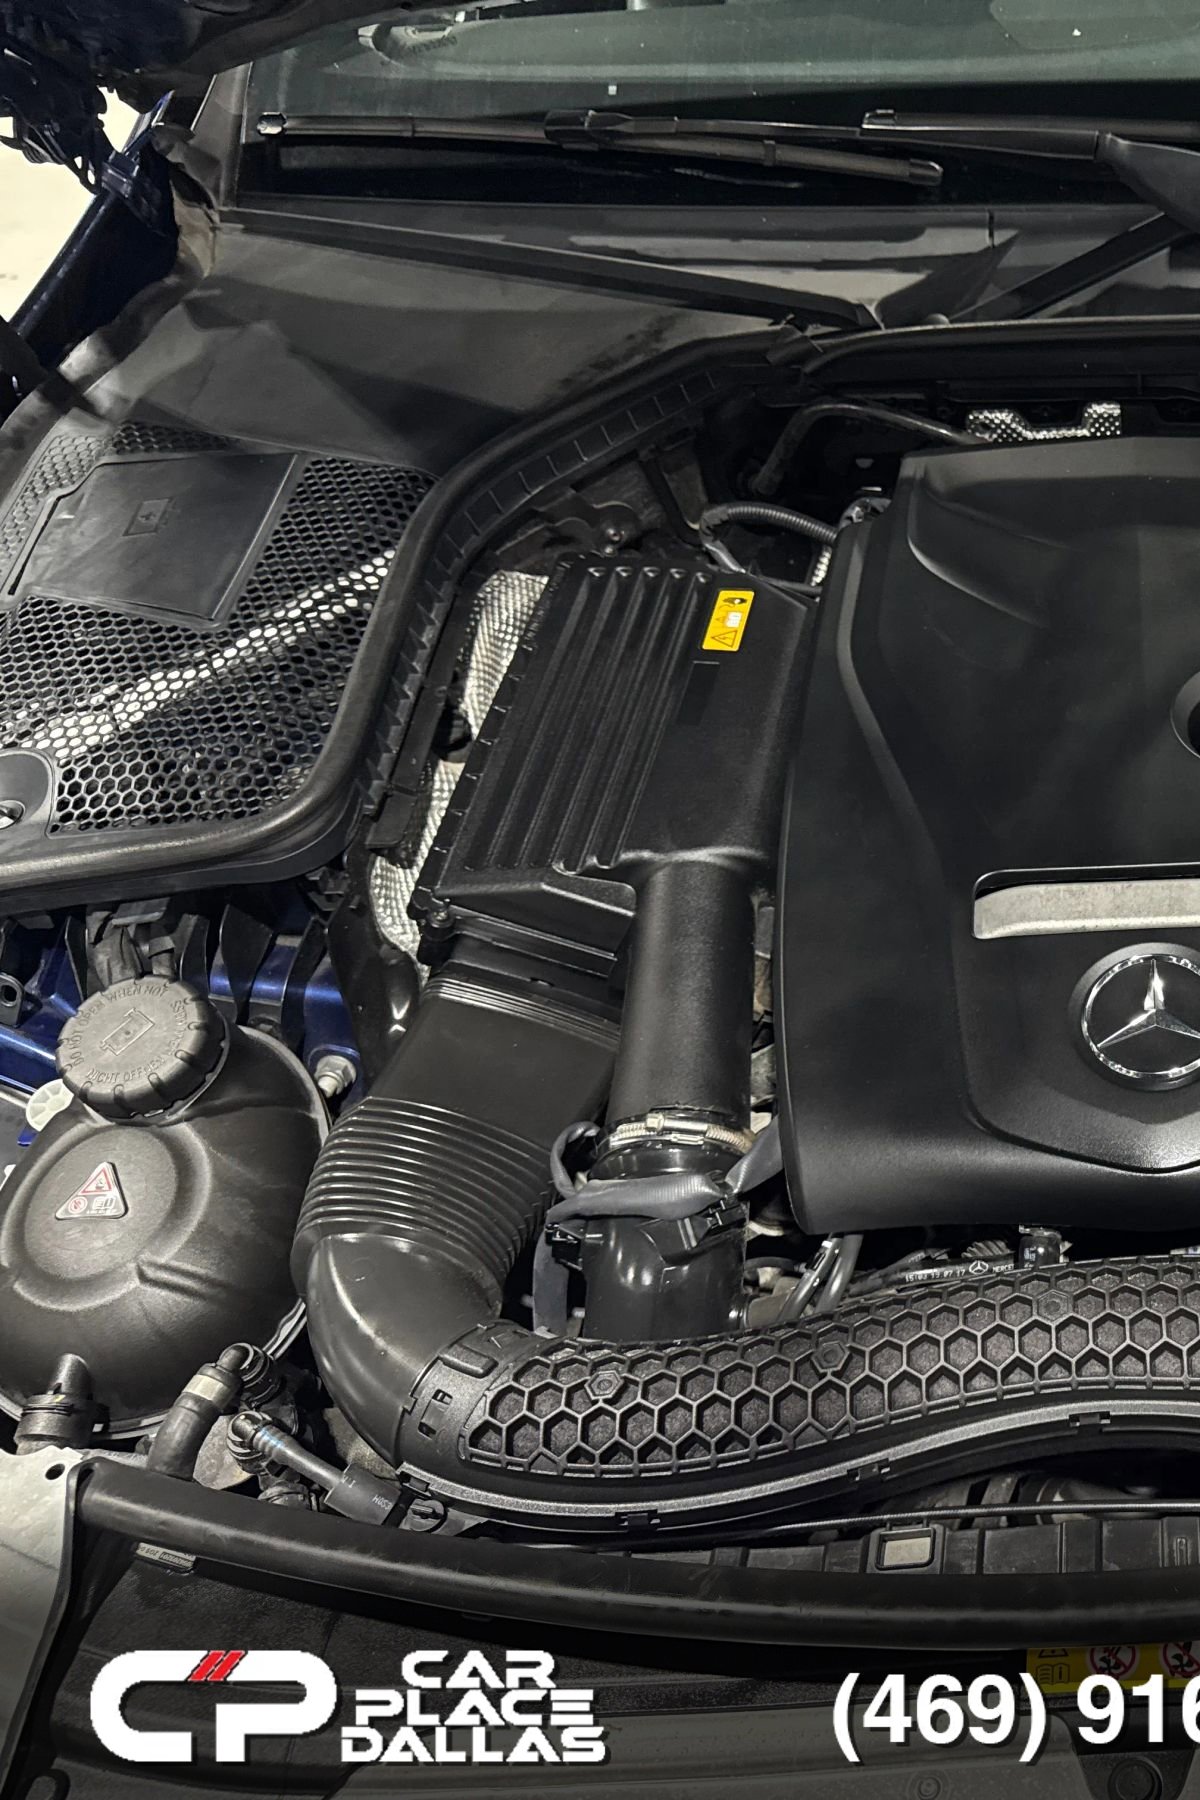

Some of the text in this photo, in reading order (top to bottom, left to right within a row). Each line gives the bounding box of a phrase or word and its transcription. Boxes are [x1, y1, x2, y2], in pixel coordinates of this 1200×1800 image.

[79, 1002, 105, 1027] OPEN
[107, 986, 142, 1003] WHEN
[143, 985, 170, 998] HOT
[85, 1067, 121, 1084] NICHT
